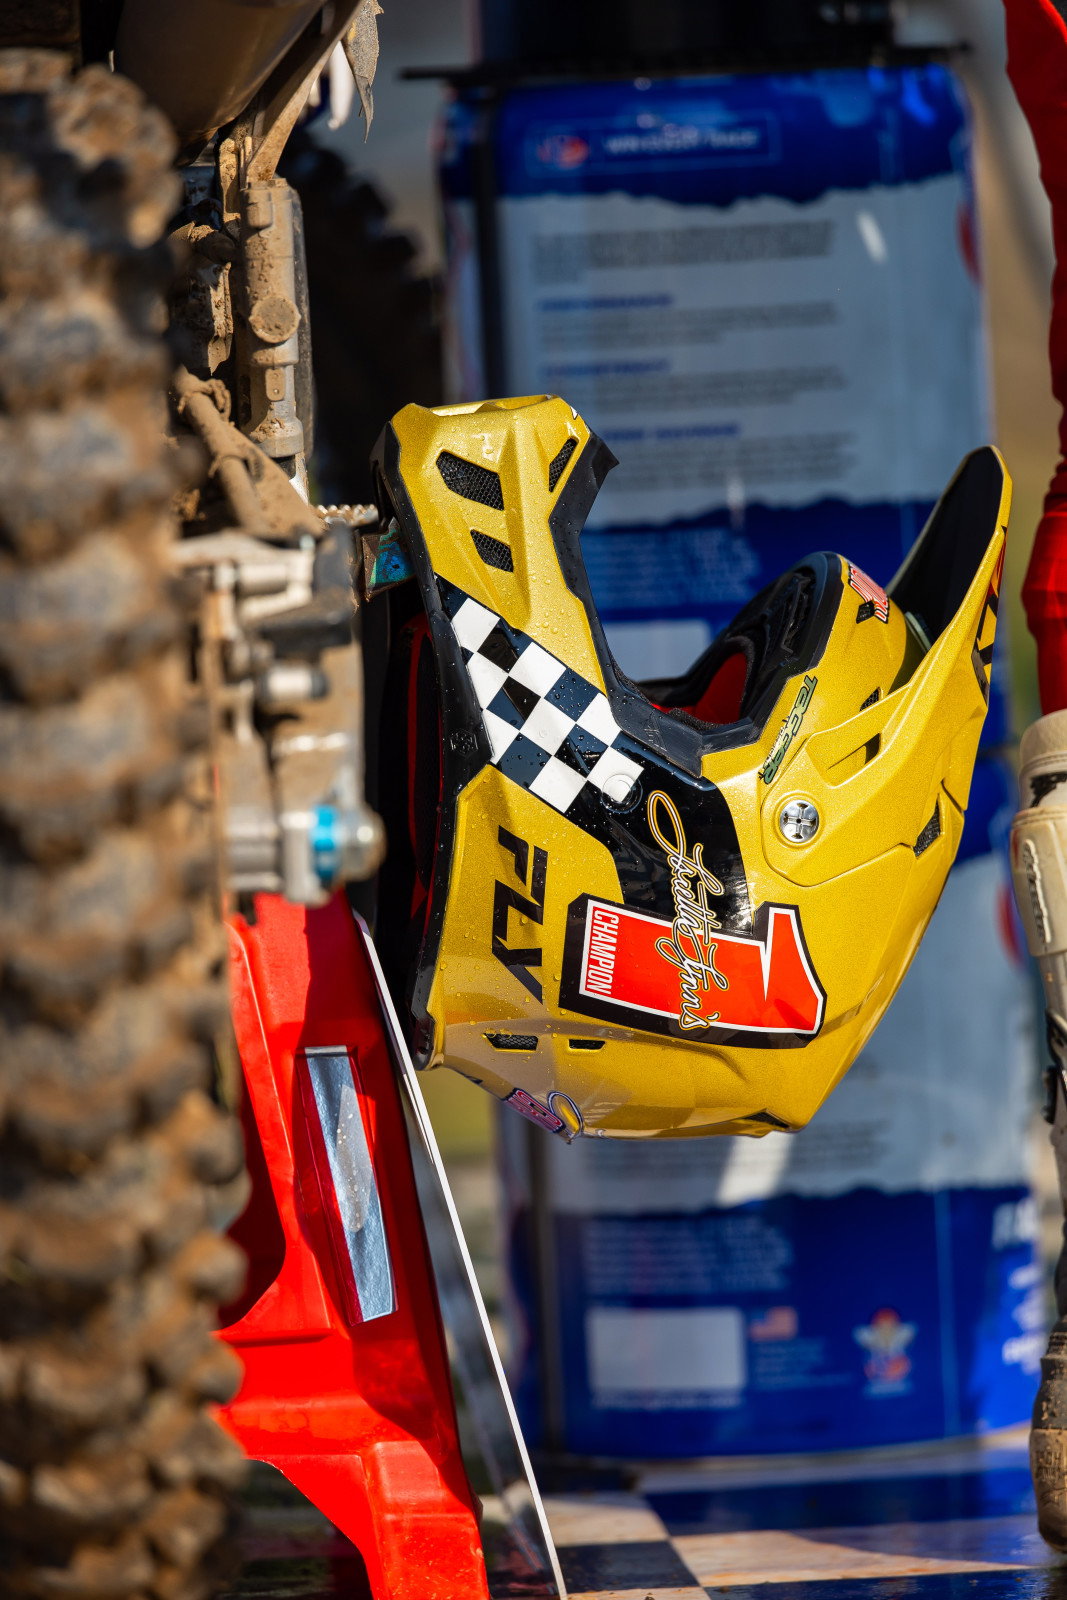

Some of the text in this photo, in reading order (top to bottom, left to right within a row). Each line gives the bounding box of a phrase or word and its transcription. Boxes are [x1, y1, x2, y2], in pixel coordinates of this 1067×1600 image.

[492, 824, 549, 1005] FLY
[586, 909, 620, 995] CHAMPION
[648, 790, 728, 1030] Loretta Lynn's
